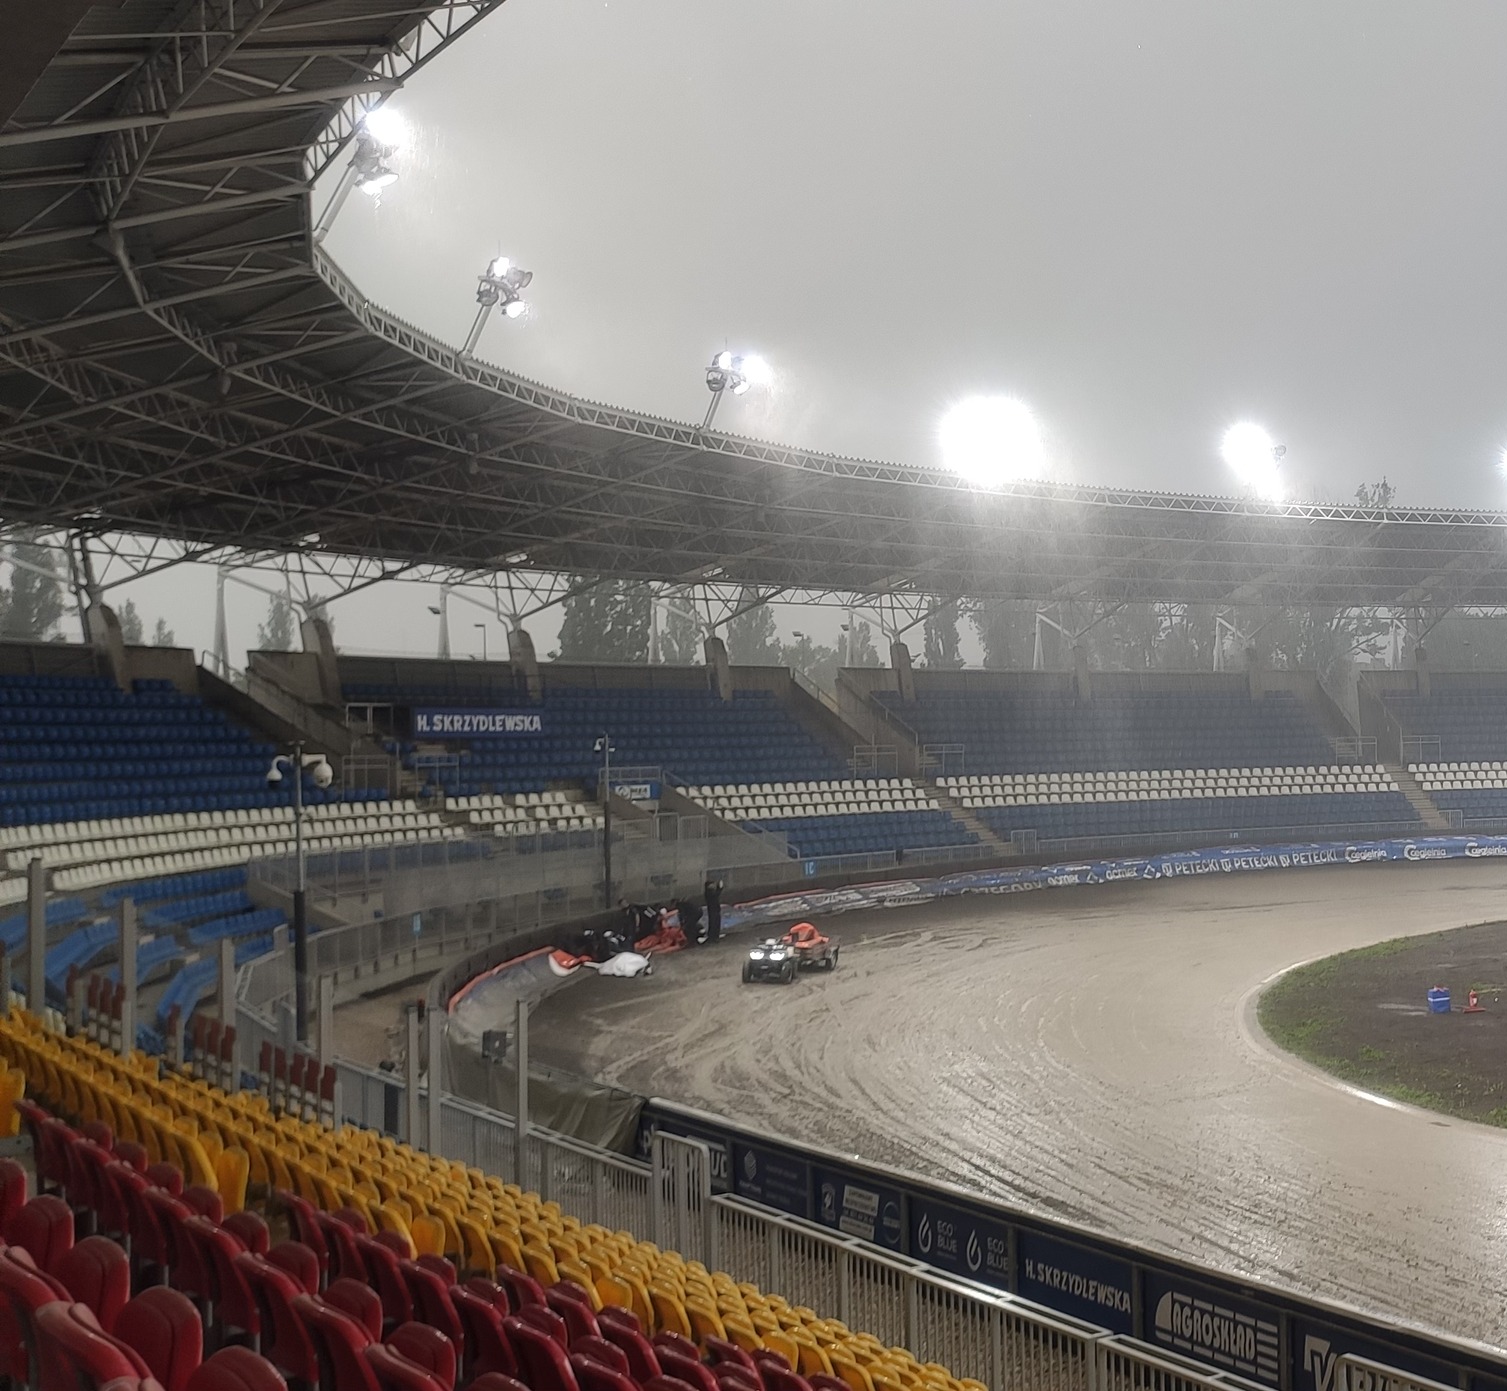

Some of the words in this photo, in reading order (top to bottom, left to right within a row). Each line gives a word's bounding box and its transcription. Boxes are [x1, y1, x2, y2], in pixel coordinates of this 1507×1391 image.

[417, 715, 430, 732] H.
[432, 714, 542, 733] SKRZYDLEWSKA
[1233, 855, 1278, 869] PETECKI
[1293, 849, 1337, 865] PETECKI
[1174, 859, 1220, 874] PETECKI
[937, 1220, 953, 1237] ECO
[937, 1235, 957, 1253] BLUE
[987, 1237, 1004, 1254] ECO
[987, 1252, 1008, 1271] BLUE
[1025, 1258, 1036, 1280] H.
[1037, 1262, 1132, 1314] SKRZYDLEWSKA
[1172, 1301, 1256, 1361] AGROSKŁAD
